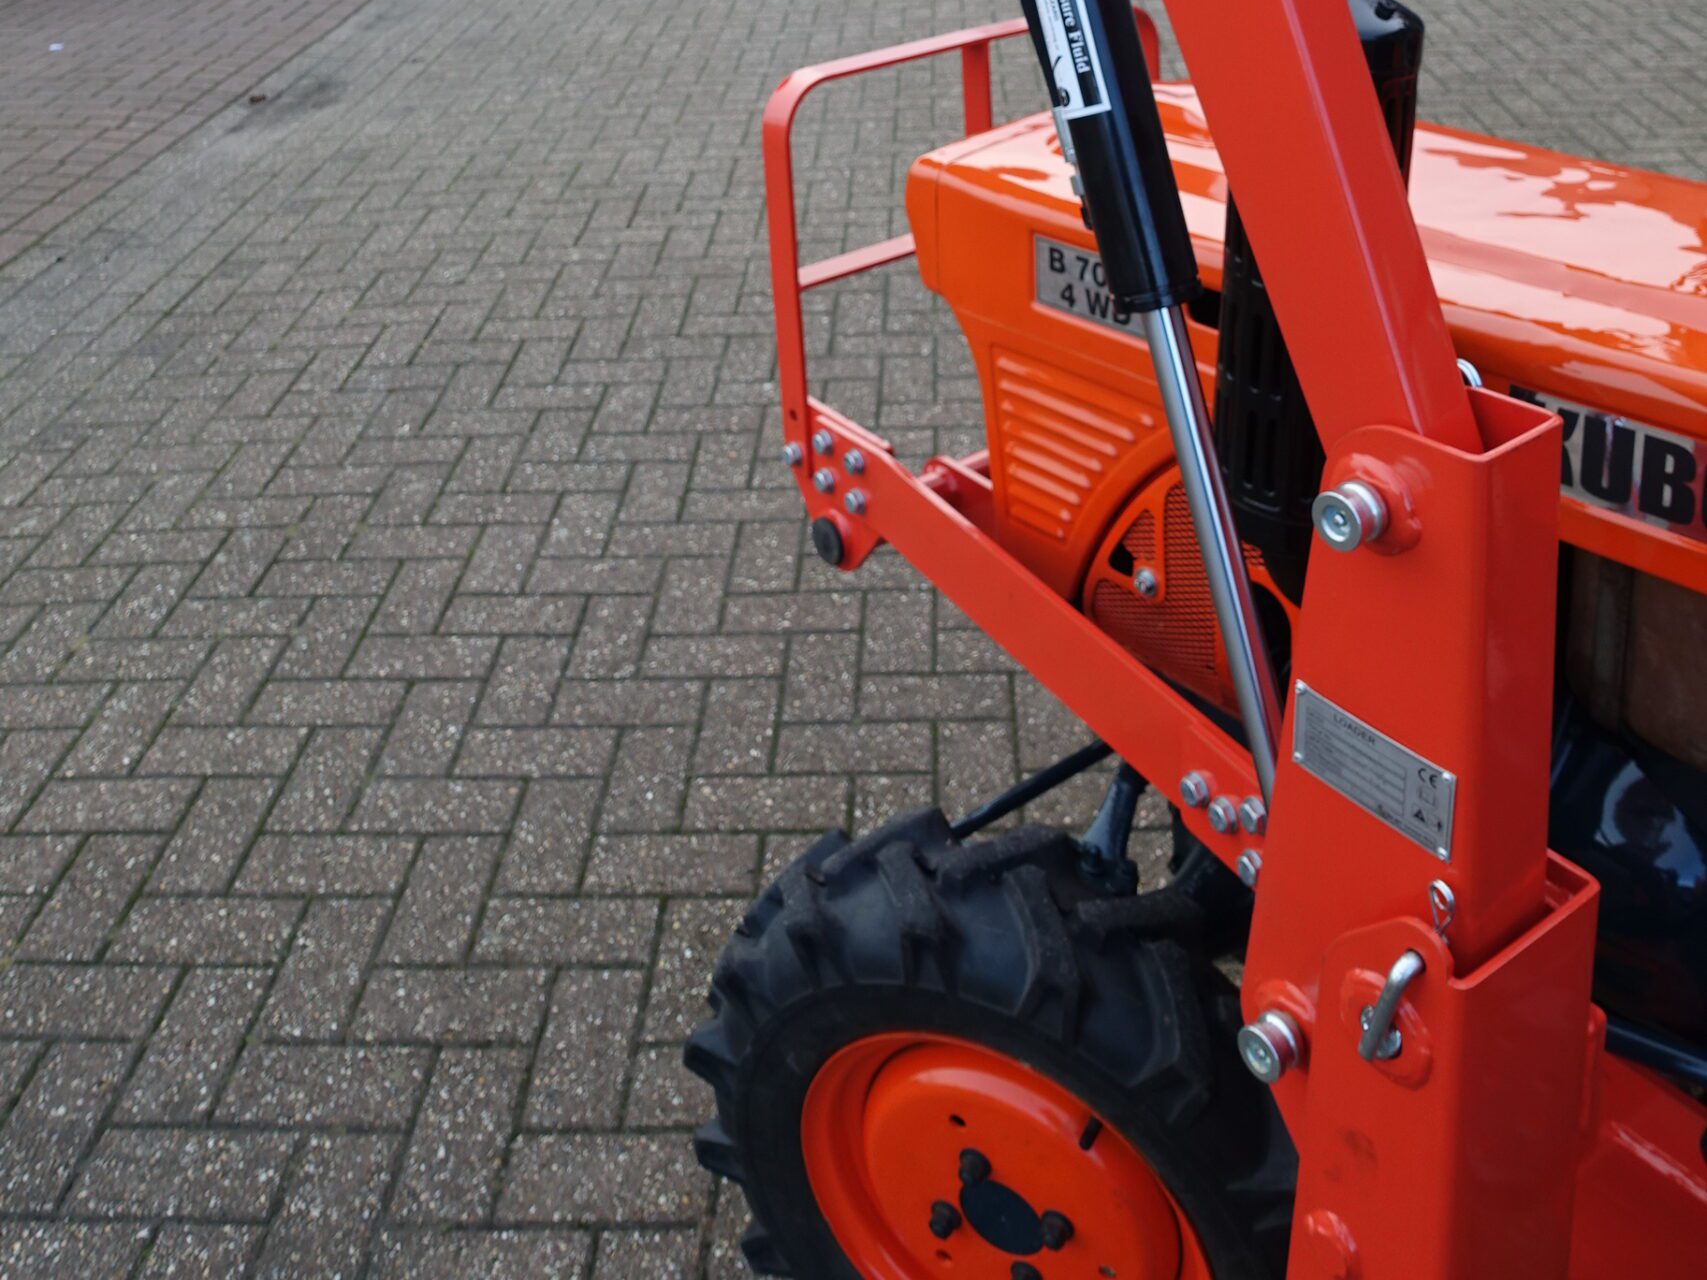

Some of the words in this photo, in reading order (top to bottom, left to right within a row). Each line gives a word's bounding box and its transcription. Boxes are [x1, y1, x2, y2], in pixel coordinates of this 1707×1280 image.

[1068, 30, 1091, 74] Fluid
[1049, 247, 1065, 274] B
[1076, 256, 1107, 287] 70
[1060, 283, 1075, 309] 4
[1524, 395, 1707, 528] UB
[1333, 714, 1376, 746] LOADER
